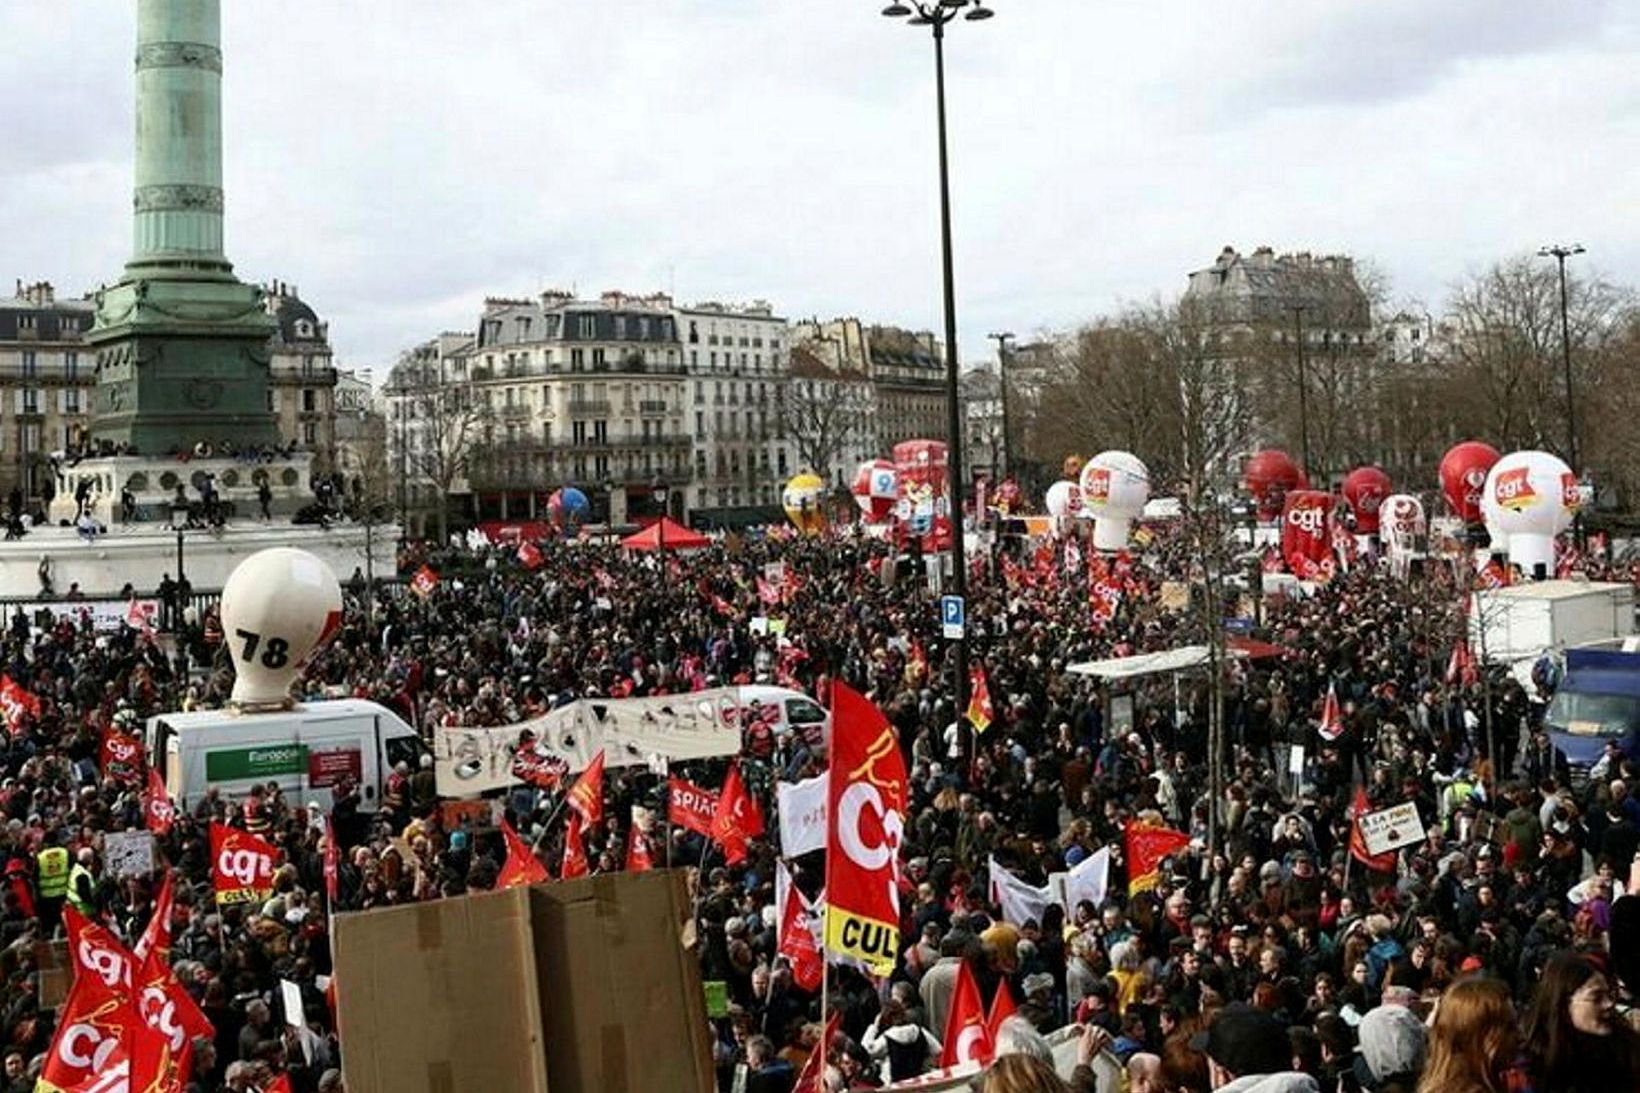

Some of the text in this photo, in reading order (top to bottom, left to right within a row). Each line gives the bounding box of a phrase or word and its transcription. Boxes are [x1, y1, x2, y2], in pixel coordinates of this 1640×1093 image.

[1497, 477, 1526, 498] cgt
[1289, 506, 1324, 532] cgt
[947, 602, 958, 621] P
[236, 628, 289, 669] 78
[219, 849, 273, 885] cgt
[842, 919, 900, 959] CUL
